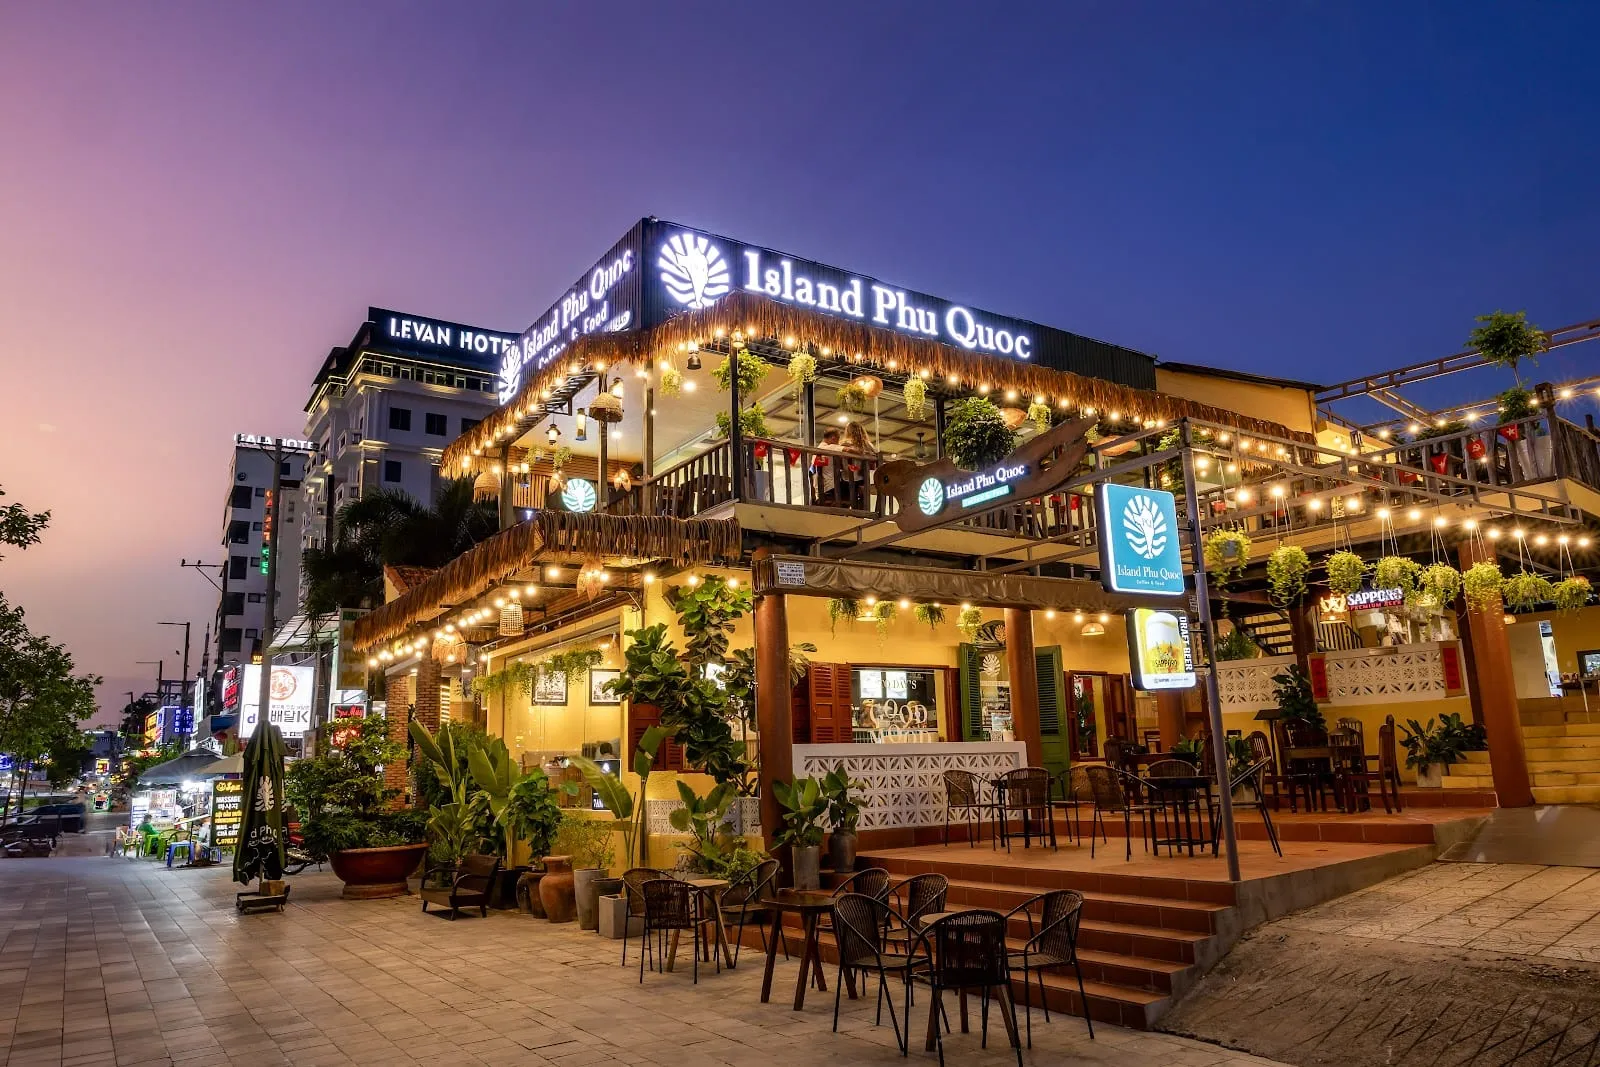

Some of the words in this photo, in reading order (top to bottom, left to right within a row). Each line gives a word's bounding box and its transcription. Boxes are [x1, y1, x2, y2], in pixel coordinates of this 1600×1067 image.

[522, 309, 559, 364] Island
[562, 291, 588, 329] Phu
[590, 249, 631, 300] Quoc
[583, 300, 608, 334] Food
[744, 250, 865, 318] Island
[872, 285, 938, 336] Phu
[946, 306, 1031, 358] Quoc
[389, 317, 451, 347] LEVAN
[459, 331, 514, 354] HOTE
[946, 479, 975, 499] Island
[975, 474, 995, 489] Phu
[996, 465, 1025, 481] Quoc
[1117, 564, 1141, 577] Island
[1143, 566, 1159, 578] Phu
[1160, 567, 1181, 580] Quoc
[1346, 587, 1403, 606] SAPPORO
[1179, 616, 1190, 645] DRAFT
[1183, 647, 1193, 671] BEER
